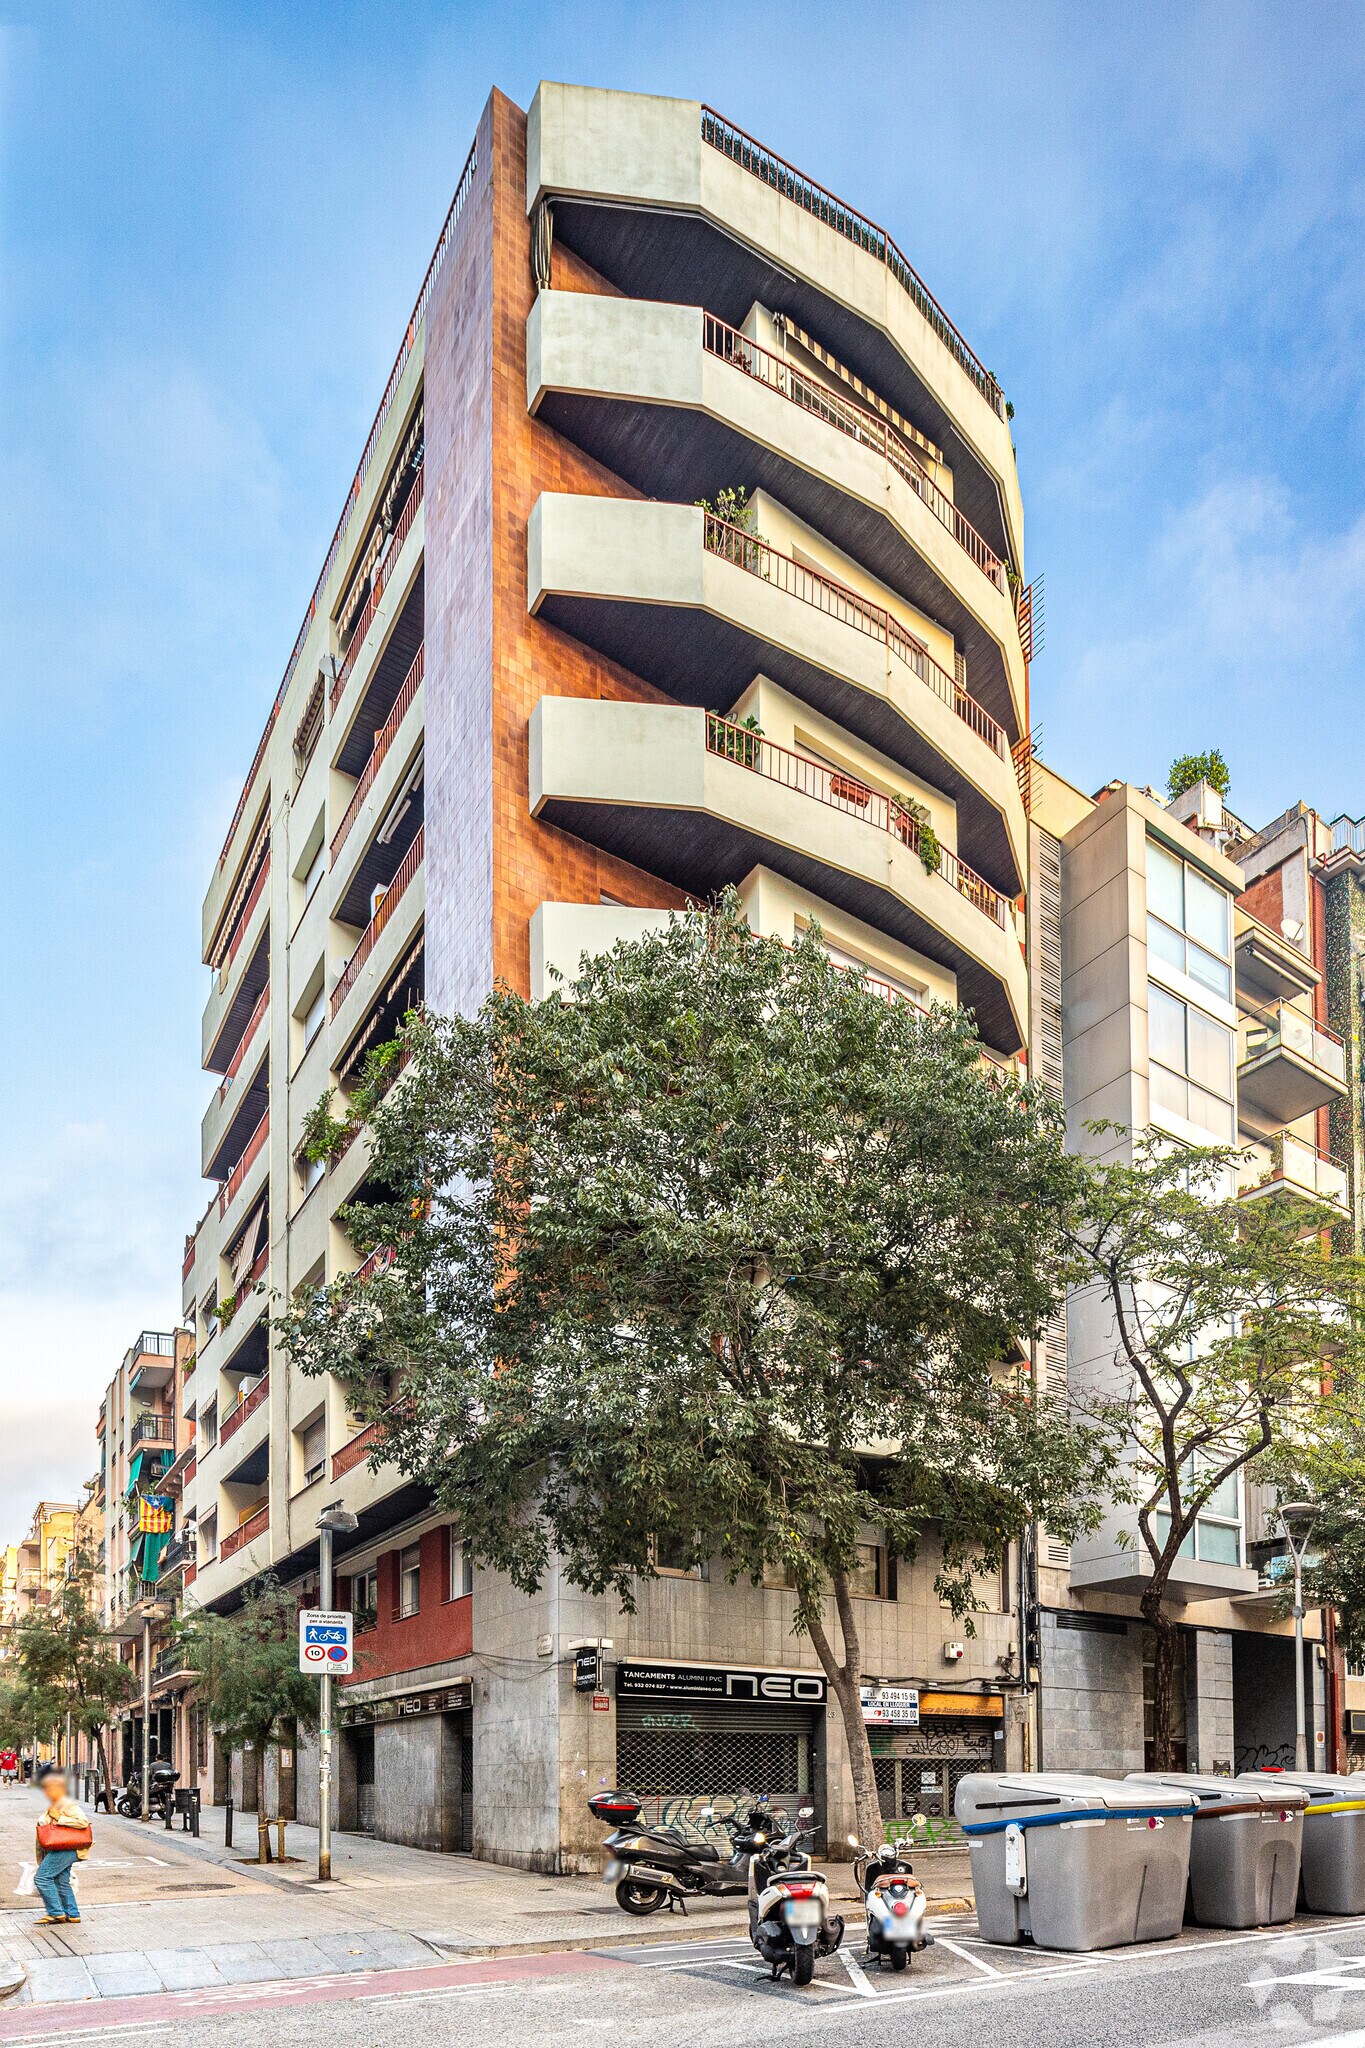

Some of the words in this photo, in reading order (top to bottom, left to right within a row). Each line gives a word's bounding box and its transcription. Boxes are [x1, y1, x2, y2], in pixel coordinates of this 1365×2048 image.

[623, 1671, 676, 1680] TANCAMENTS
[882, 1691, 889, 1700] 93
[890, 1692, 900, 1700] 494
[901, 1692, 909, 1700] 15
[882, 1709, 889, 1718] 93
[890, 1709, 901, 1718] 458
[901, 1710, 909, 1718] 35
[909, 1710, 917, 1719] 00
